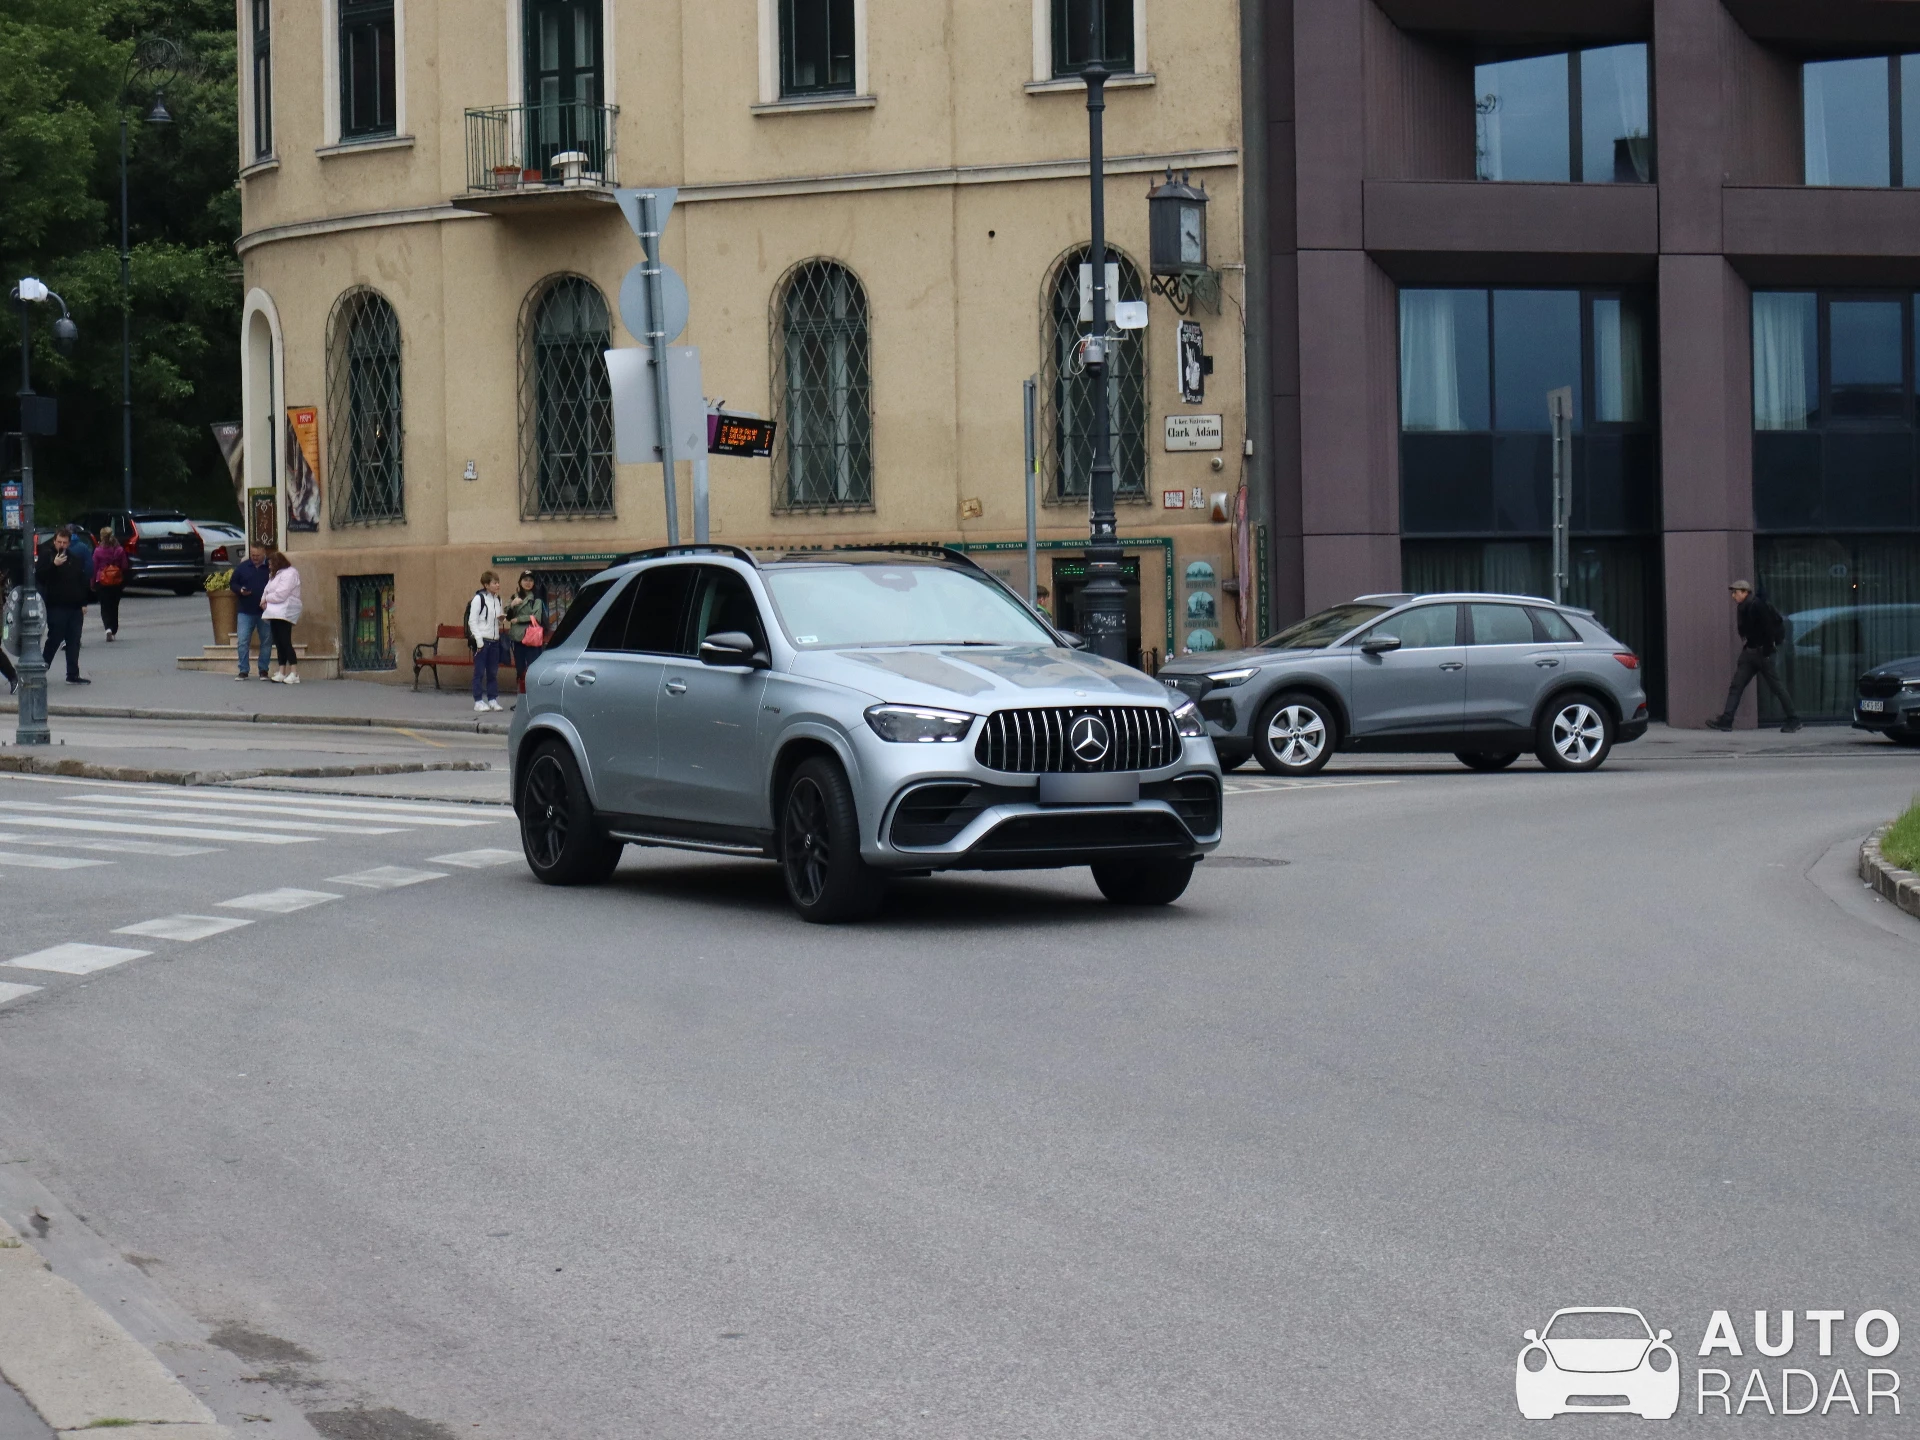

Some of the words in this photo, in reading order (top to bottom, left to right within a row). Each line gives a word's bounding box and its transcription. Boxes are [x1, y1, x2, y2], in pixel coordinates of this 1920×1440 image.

[1167, 427, 1190, 438] Clark
[1196, 425, 1219, 437] Ádám
[1259, 527, 1267, 638] DELIKATESZ
